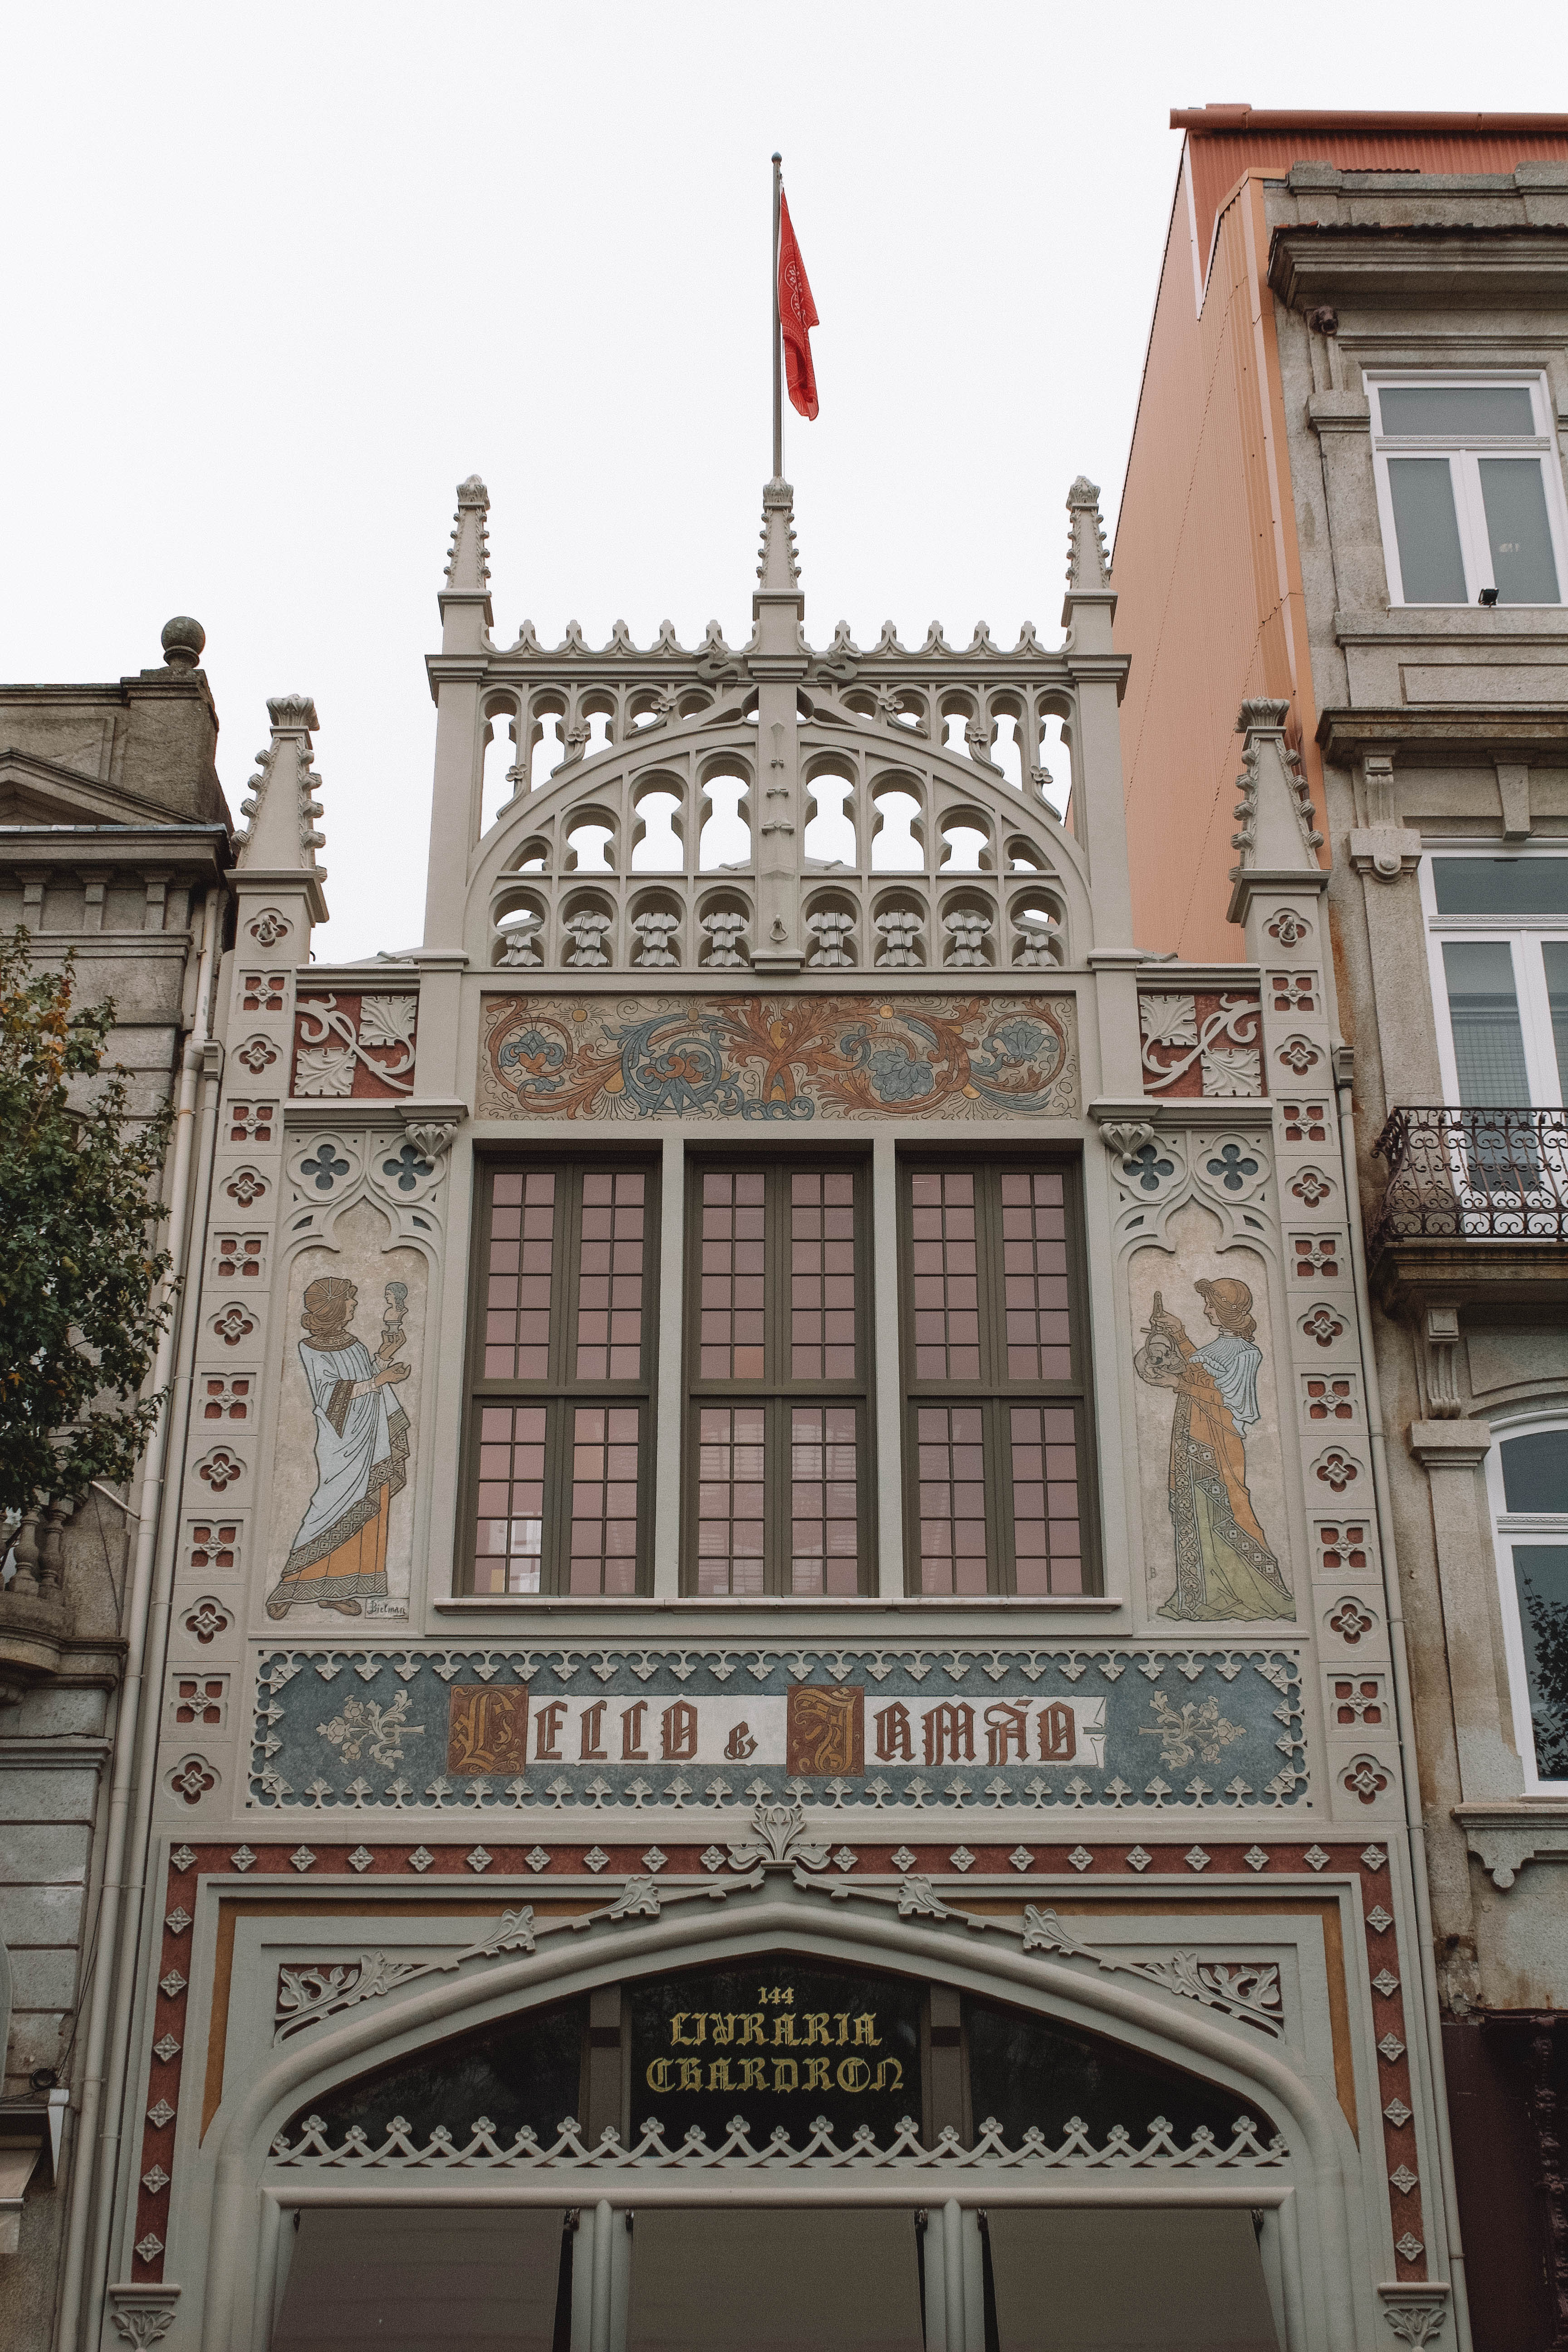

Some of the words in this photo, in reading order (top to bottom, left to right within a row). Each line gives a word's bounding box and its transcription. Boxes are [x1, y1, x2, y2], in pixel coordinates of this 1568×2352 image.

[450, 1687, 698, 1773] LELLO
[724, 1721, 759, 1760] &
[758, 1986, 794, 2004] 144
[669, 2013, 882, 2046] LIVRARIA
[646, 2057, 904, 2094] CHARDRON
